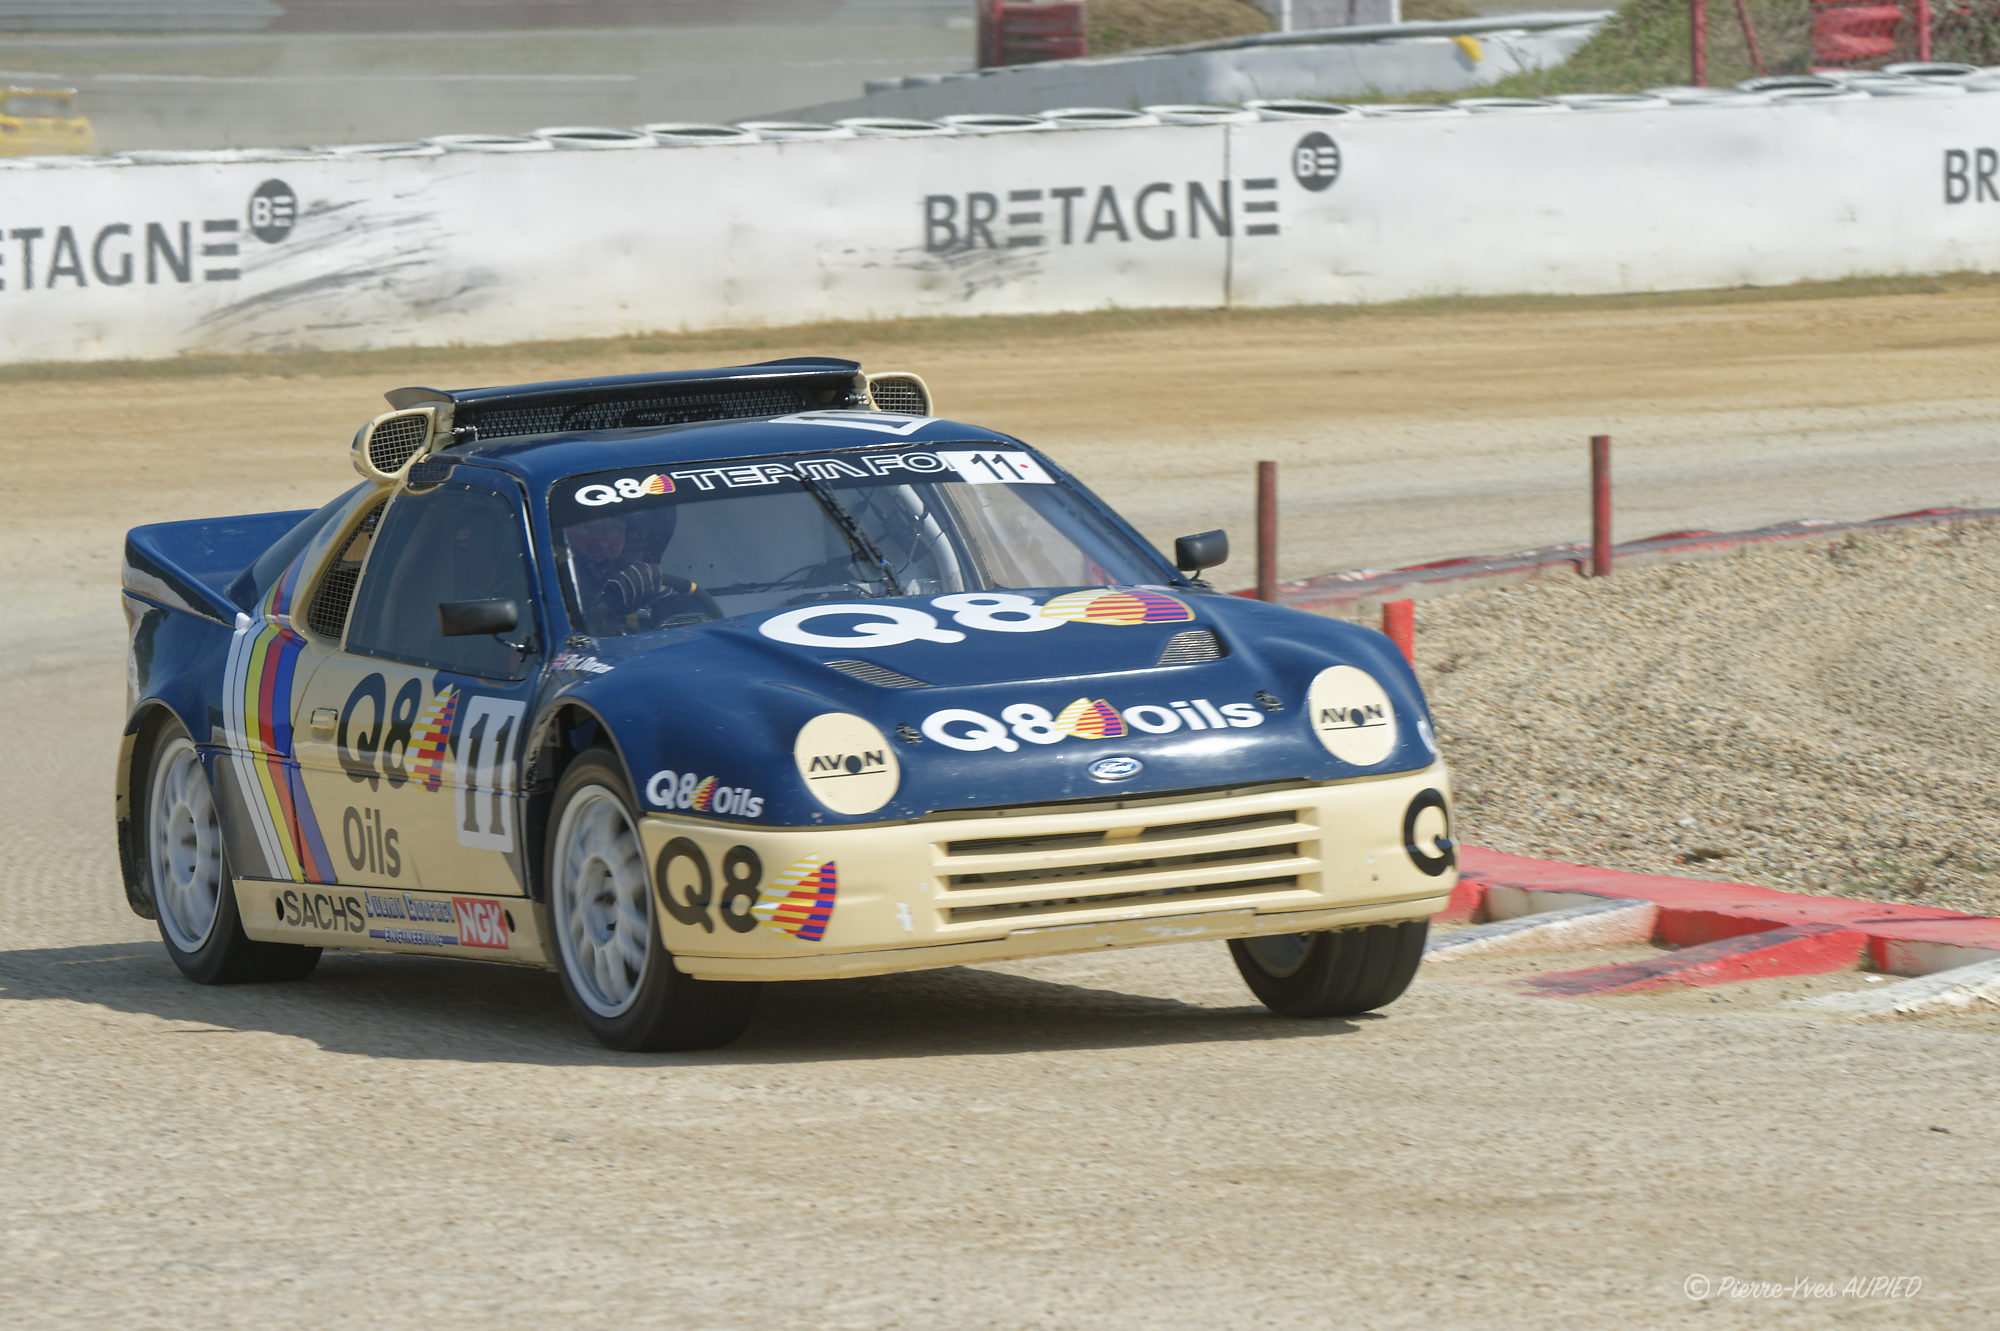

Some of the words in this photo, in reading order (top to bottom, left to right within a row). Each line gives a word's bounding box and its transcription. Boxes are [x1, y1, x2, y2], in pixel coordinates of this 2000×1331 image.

[924, 178, 1279, 253] BRETAGNE
[0, 218, 241, 290] TAGNE
[575, 477, 647, 506] Q8
[670, 458, 870, 492] TEAM
[861, 451, 957, 477] FO
[971, 453, 1024, 481] 11
[759, 593, 1068, 648] Q8
[337, 672, 422, 792] Q8
[921, 702, 1067, 753] Q8
[1125, 699, 1264, 734] Oils
[1320, 704, 1385, 727] AVON
[462, 713, 516, 836] 11
[809, 749, 885, 775] AVON
[646, 769, 697, 810] Q8
[712, 786, 765, 818] Oils
[342, 805, 401, 878] Oils
[283, 890, 365, 933] SACHS
[656, 836, 764, 934] Q8
[455, 901, 506, 945] NGK
